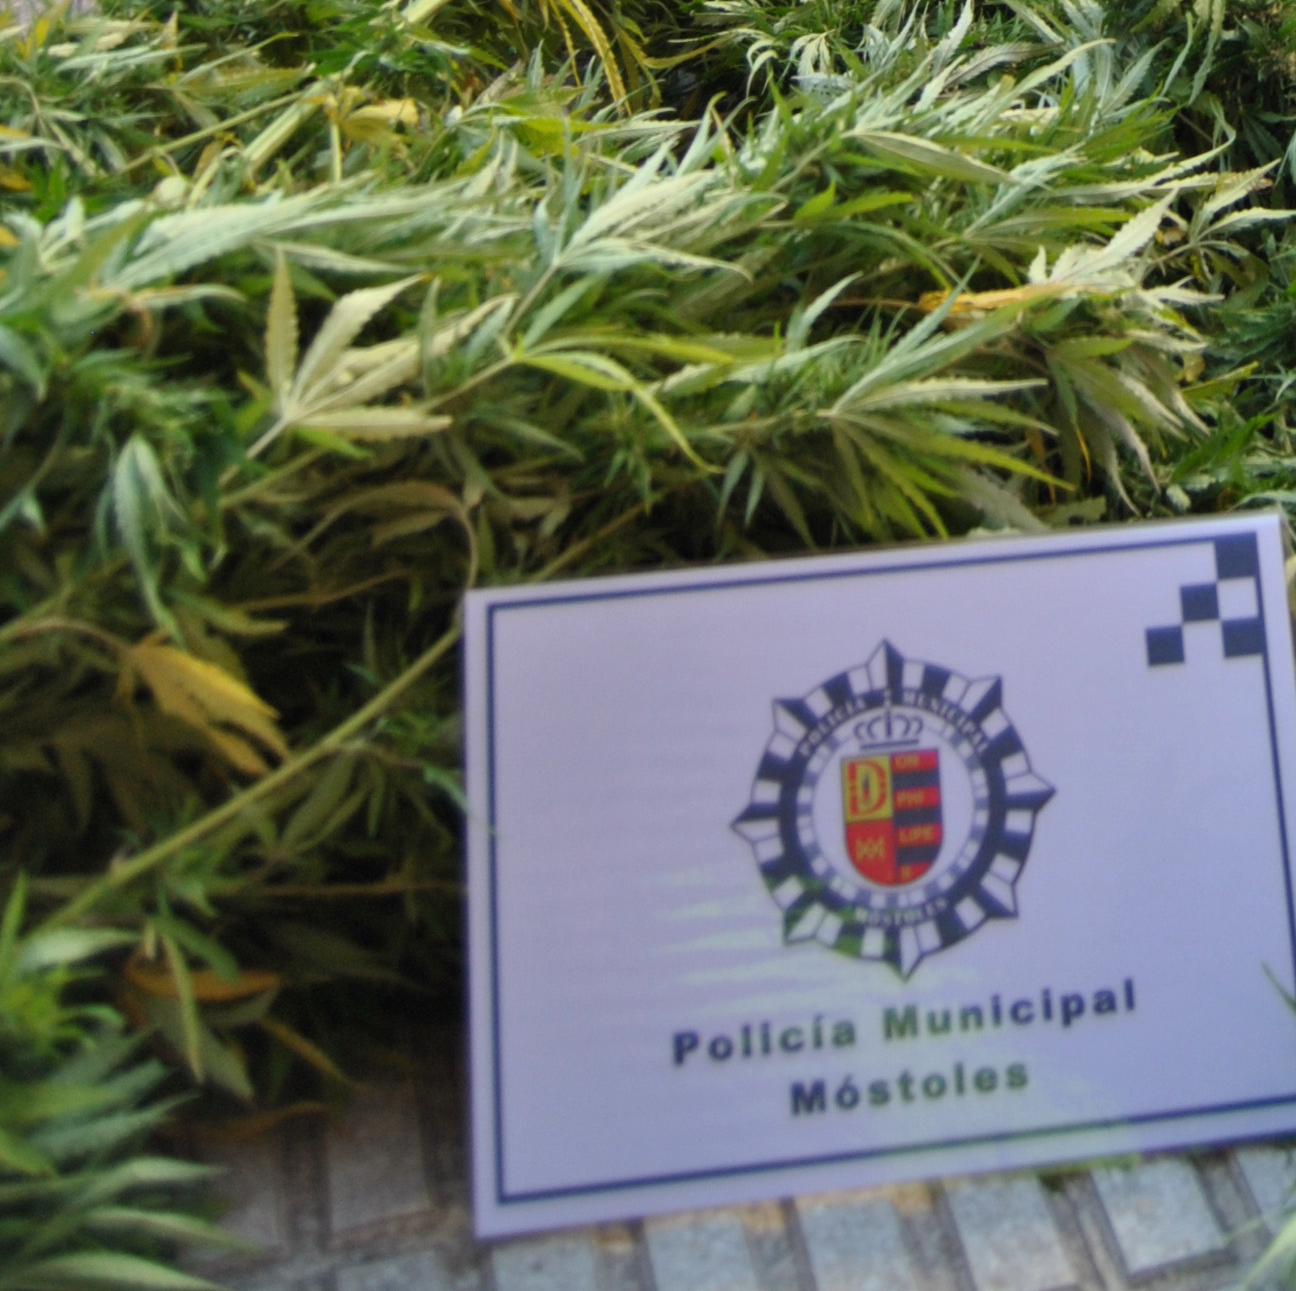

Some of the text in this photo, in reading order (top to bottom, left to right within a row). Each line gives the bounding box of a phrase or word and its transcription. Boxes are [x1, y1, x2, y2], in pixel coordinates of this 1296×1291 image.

[673, 977, 1136, 1066] Policía Municipal
[791, 1061, 1029, 1116] Móstoles
